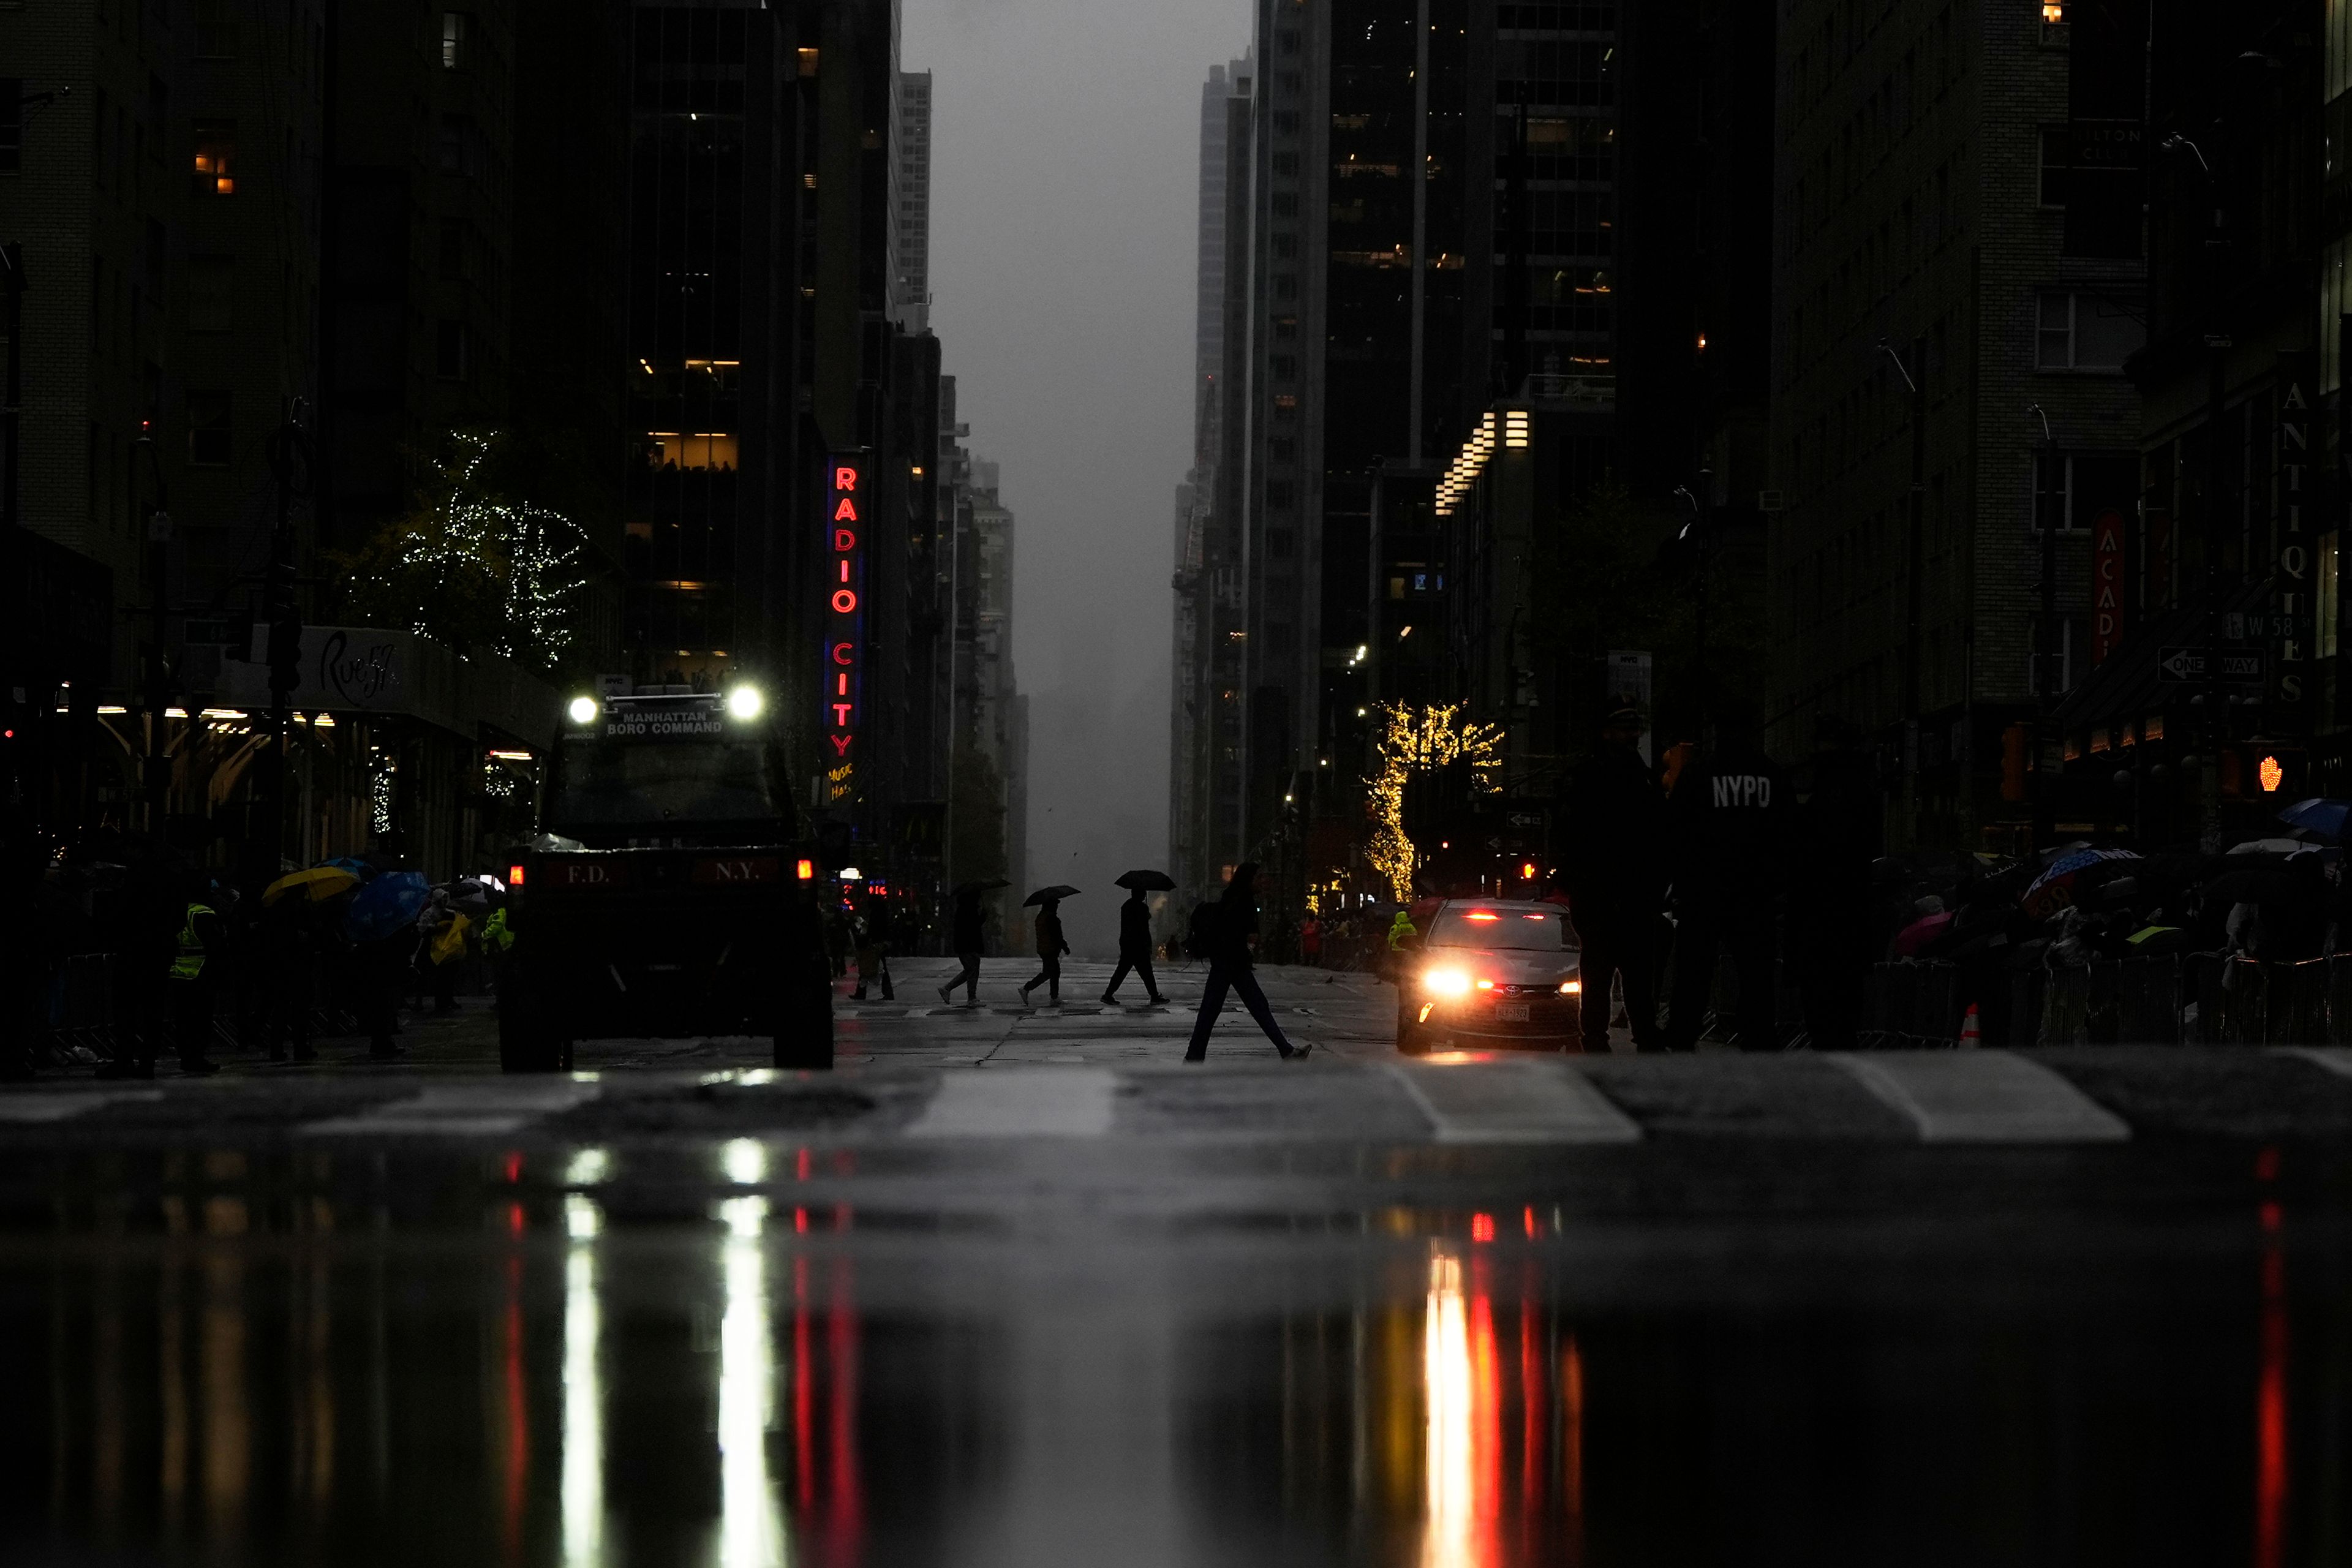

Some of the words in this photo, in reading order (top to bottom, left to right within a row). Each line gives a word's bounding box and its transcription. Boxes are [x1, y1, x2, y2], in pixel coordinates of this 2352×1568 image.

[2072, 129, 2141, 141] HILTON
[832, 467, 856, 613] RADIO
[2280, 382, 2309, 703] ANTIQUES
[2248, 617, 2264, 636] W
[2272, 617, 2293, 636] 58
[321, 630, 368, 706] Rue
[2173, 658, 2204, 671] ONE
[2221, 658, 2254, 672] WAY
[831, 643, 853, 756] CITY
[623, 711, 706, 723] MANHATTAN
[607, 723, 646, 735] BORO
[651, 722, 723, 734] COMMAND
[1712, 774, 1771, 808] NYPD
[568, 865, 609, 883] F.D.
[715, 861, 760, 881] N.Y.
